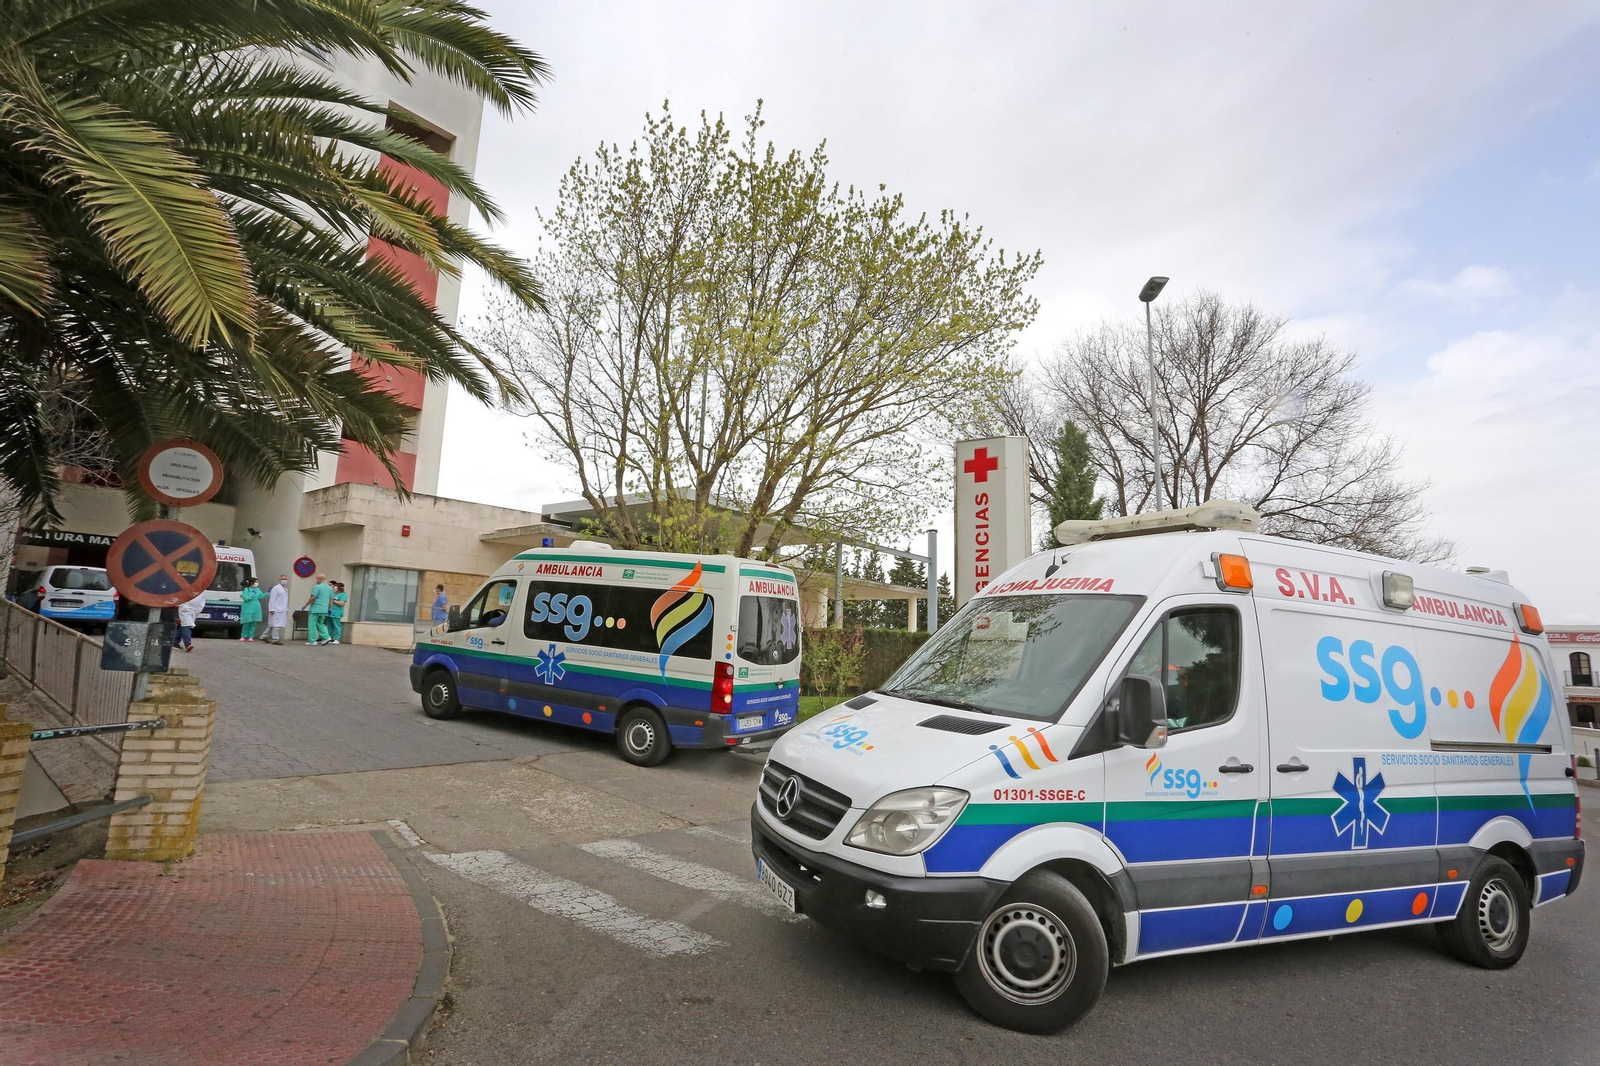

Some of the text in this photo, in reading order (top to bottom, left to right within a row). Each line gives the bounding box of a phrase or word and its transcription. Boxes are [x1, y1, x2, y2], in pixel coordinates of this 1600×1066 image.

[23, 531, 116, 546] ALTURA MA
[536, 563, 603, 578] AMBULANCIA
[749, 580, 795, 597] AMBULANCIA
[1275, 567, 1508, 627] S.V.A. AMBULANCIA
[566, 646, 658, 664] SERVICIOS SOCIO SANITARIOS GENERALES
[1316, 635, 1427, 740] ssg
[1381, 753, 1515, 766] SERVICIOS SOCIO SANITARIOS GENERALES
[993, 788, 1086, 801] 01301-SSGE-C
[777, 882, 793, 908] GZZ
